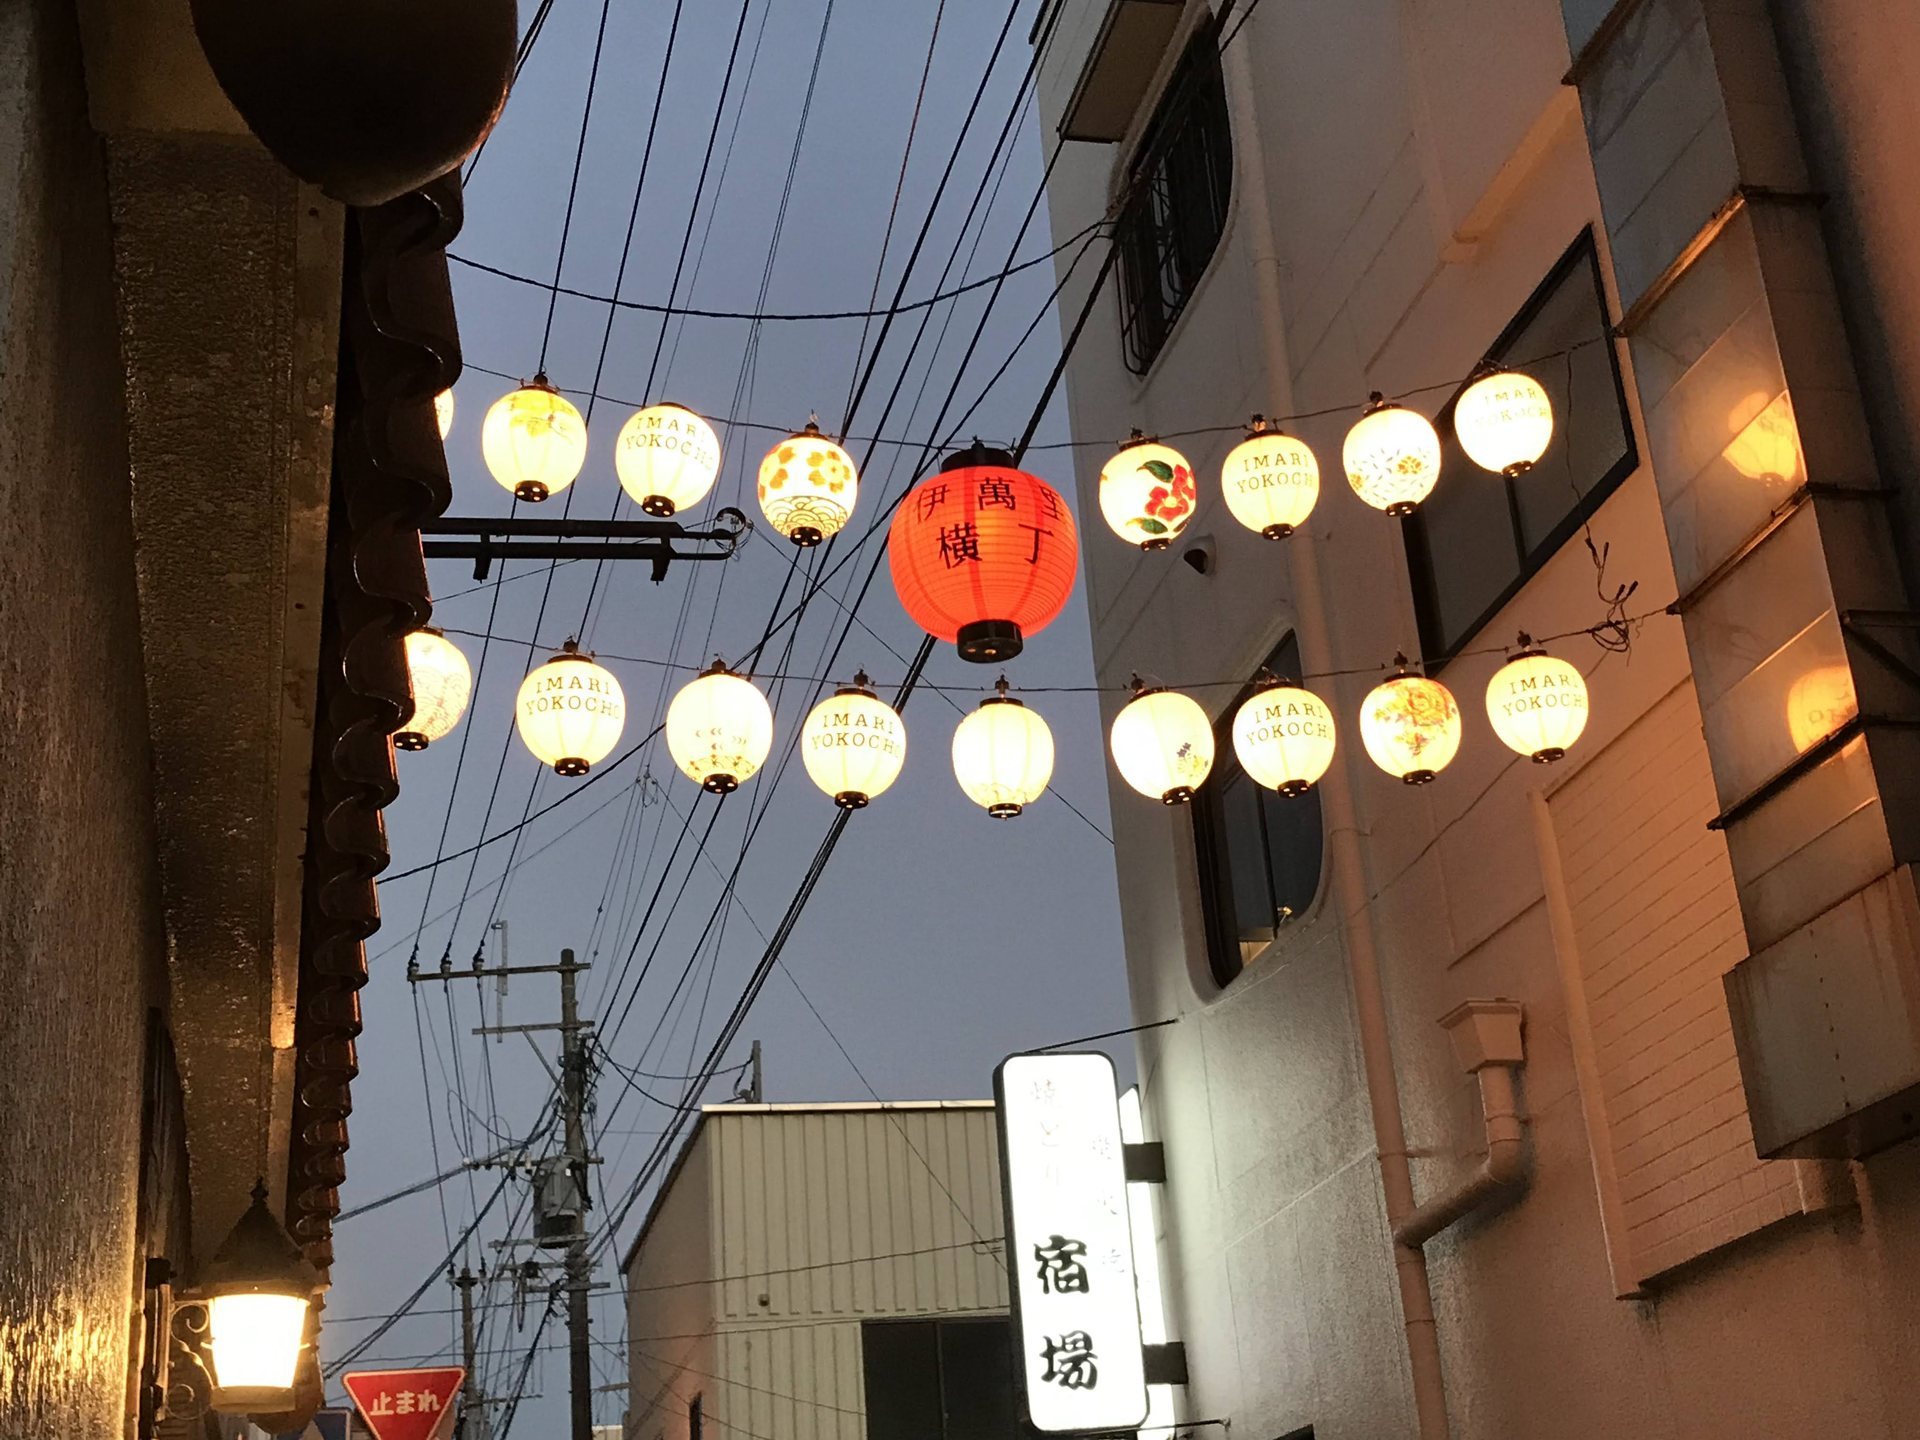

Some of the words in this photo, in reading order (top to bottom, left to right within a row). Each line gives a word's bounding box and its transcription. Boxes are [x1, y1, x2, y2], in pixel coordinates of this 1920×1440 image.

[936, 522, 1054, 570] 横丁
[536, 676, 610, 695] IMARI
[823, 713, 893, 735] IMARI
[1256, 703, 1324, 724] IMARI
[1246, 722, 1330, 746] YOKOCH
[1033, 1234, 1098, 1391] 宿場
[370, 1389, 441, 1416] 止まれ
